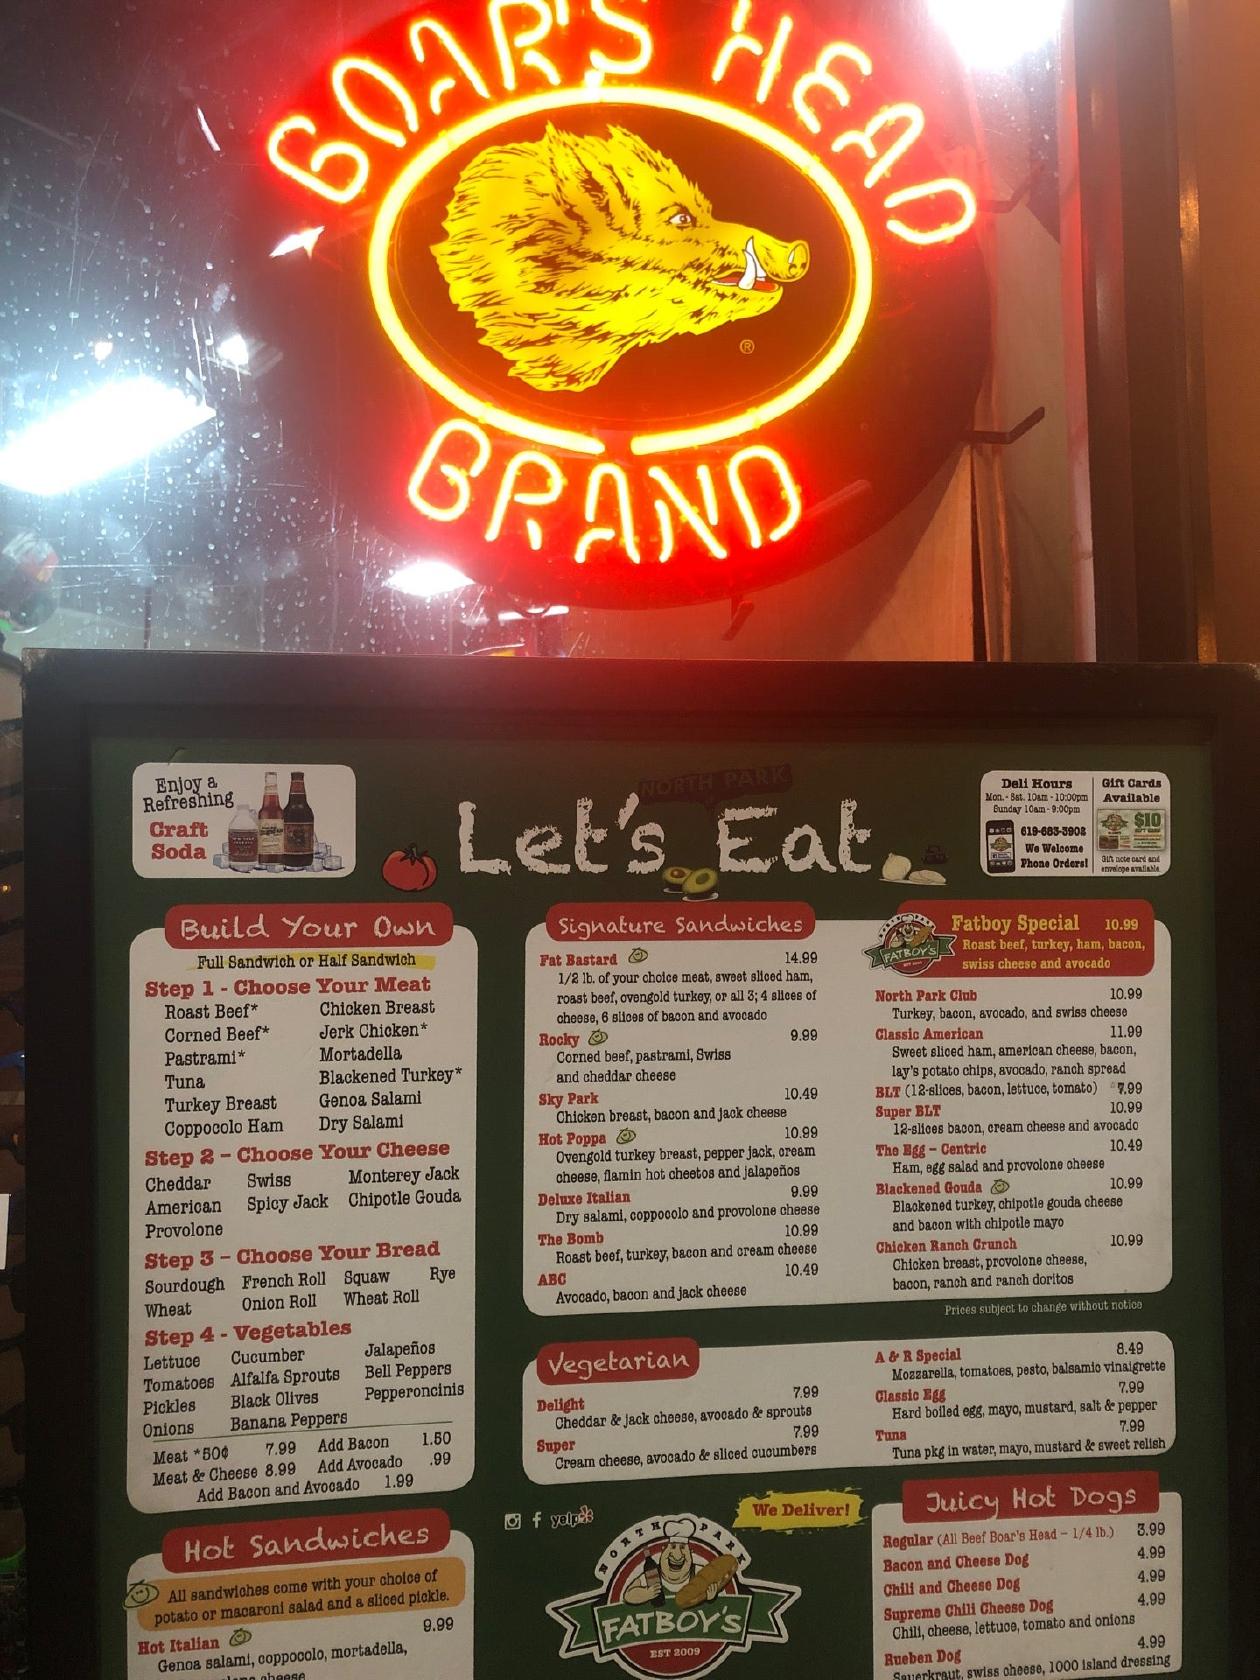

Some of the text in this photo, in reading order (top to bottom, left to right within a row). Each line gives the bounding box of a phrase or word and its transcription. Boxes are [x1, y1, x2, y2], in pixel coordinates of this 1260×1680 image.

[711, 0, 979, 246] HEAD
[406, 418, 803, 564] BRAND
[155, 776, 217, 793] Enjoy a
[642, 765, 788, 797] NORTH PARK
[1001, 777, 1072, 788] Deli Hours
[1101, 777, 1161, 788] Gift Cards
[143, 791, 234, 813] Refreshing
[1102, 792, 1160, 802] Available
[149, 821, 208, 837] Craft
[458, 792, 872, 875] Let's Eat
[151, 842, 207, 860] Soda
[1024, 843, 1083, 853] We Welcome
[1020, 857, 1088, 868] Phone Orders!
[1101, 854, 1114, 863] Gift
[181, 913, 436, 941] Build Your Own
[558, 916, 803, 940] Signature Sandwiches
[951, 914, 1012, 935] Fatboy
[1017, 913, 1079, 935] Special
[1105, 918, 1138, 930] 10.99
[196, 952, 416, 969] Full Sandwich or Half Sandwich
[539, 953, 618, 966] Fat Bastard
[785, 951, 817, 964] 14.99
[884, 945, 937, 963] FATBOY'S
[962, 956, 1110, 969] swiss cheese and avocado
[875, 989, 977, 1002] North Park Club
[1110, 987, 1142, 1000] 10.99
[319, 999, 435, 1016] Chicken Breast
[538, 1032, 580, 1048] Rocky
[790, 1028, 817, 1041] 9.99
[319, 1045, 402, 1061] Mortadella
[556, 1047, 731, 1064] Corned beef, pastrami, Swiss
[164, 1074, 205, 1089] Tuna
[319, 1090, 421, 1108] Genoa Salami
[538, 1091, 599, 1109] Sky Park
[784, 1087, 817, 1100] 10.49
[164, 1095, 277, 1115] Turkey Breast
[164, 1118, 283, 1138] Coppocolo Ham
[318, 1113, 403, 1133] Dry Salami
[538, 1131, 606, 1147] Hot Poppa
[145, 1175, 211, 1192] Cheddar
[247, 1172, 291, 1188] Swiss
[348, 1165, 459, 1185] Monterey Jack
[875, 1180, 982, 1195] Blackened Gouda
[247, 1193, 328, 1214] Spicy Jack
[348, 1188, 461, 1208] Chipotle Gouda
[537, 1190, 630, 1206] Deluxe Italian
[144, 1199, 221, 1215] American
[144, 1221, 222, 1239] Provolone
[876, 1236, 1017, 1253] Chicken Ranch Crunch
[1110, 1233, 1143, 1246] 10.99
[241, 1271, 326, 1289] French Roll
[344, 1270, 390, 1286] Squaw
[429, 1266, 455, 1283] Rye
[537, 1272, 566, 1286] ABC
[145, 1276, 225, 1294] Sourdough
[143, 1302, 192, 1318] Wheat
[944, 1299, 1142, 1316] Prices subject to change without notice
[231, 1347, 305, 1365] Cucumber
[364, 1340, 435, 1359] Jalapeños
[143, 1355, 200, 1370] Lettuce
[364, 1363, 451, 1379] Bell Peppers
[548, 1350, 693, 1384] Vegetarian
[364, 1382, 464, 1403] Pepperoncinis
[793, 1385, 818, 1398] 7.99
[875, 1388, 946, 1403] Classic Egg
[536, 1397, 584, 1414] Delight
[1119, 1418, 1144, 1432] 7.99
[422, 1431, 451, 1446] 1.50
[875, 1429, 906, 1441] Tuna
[317, 1437, 389, 1452] Add Bacon
[752, 1502, 849, 1516] We Deliver!
[926, 1485, 1137, 1520] Juicy Hot Dogs
[551, 1513, 580, 1528] yelp
[1137, 1521, 1165, 1536] 3.99
[185, 1523, 429, 1562] Hot Sandwiches
[599, 1522, 747, 1574] NORTH PARK
[167, 1567, 438, 1604] All sandwiches come with your choice of
[883, 1577, 1020, 1597] Chili and Cheese Dog
[423, 1616, 453, 1632] 9.99
[601, 1606, 742, 1643] FATBOY'S
[137, 1636, 220, 1655] Hot Italian
[649, 1647, 701, 1658] EST 2009
